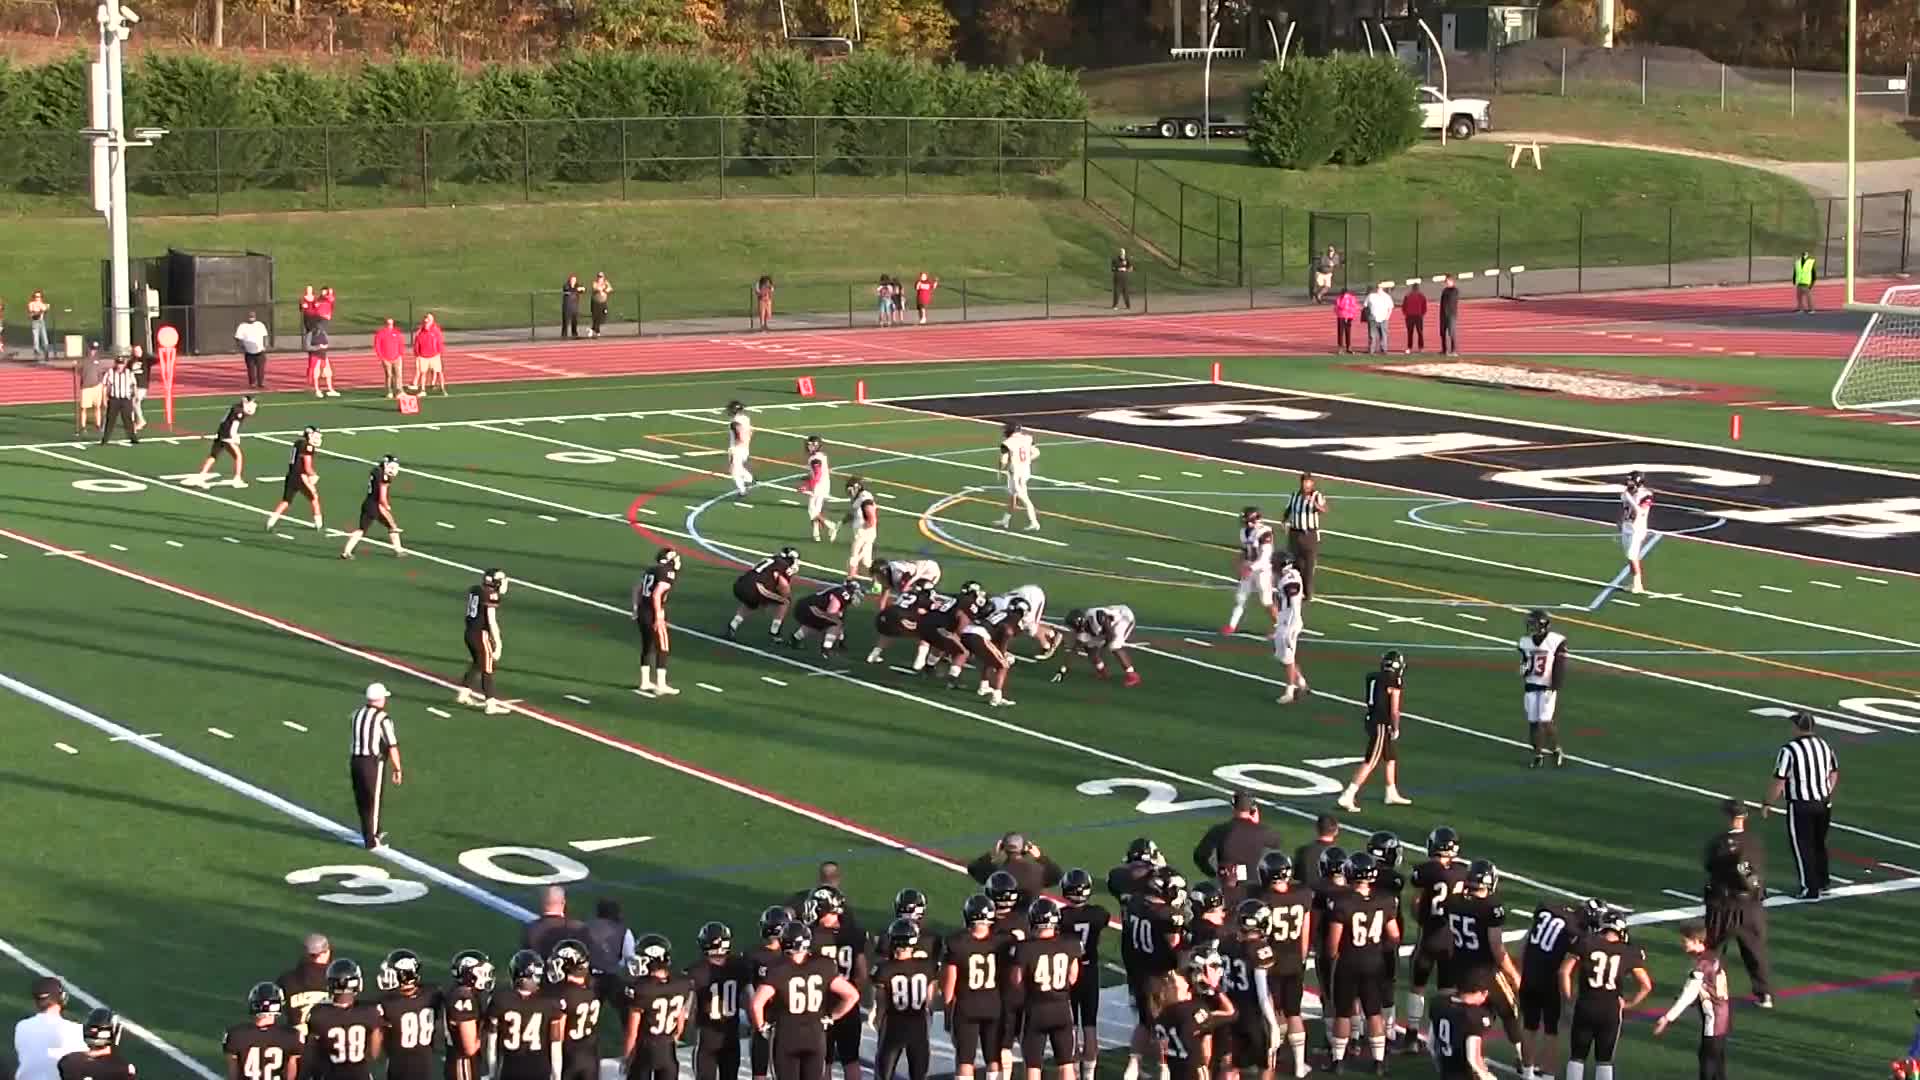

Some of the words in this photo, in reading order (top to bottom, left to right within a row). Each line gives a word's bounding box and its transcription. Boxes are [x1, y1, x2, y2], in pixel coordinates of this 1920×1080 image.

[1130, 914, 1154, 953] 70
[1273, 904, 1304, 941] 53
[1352, 910, 1384, 947] 64
[1449, 913, 1480, 951] 55
[1530, 911, 1566, 952] 30
[968, 953, 996, 990] 61
[1034, 952, 1070, 992] 48
[1588, 951, 1621, 990] 31
[709, 979, 738, 1020] 10
[788, 974, 823, 1015] 66
[891, 972, 928, 1011] 80
[327, 1025, 367, 1064] 38
[400, 1007, 435, 1049] 88
[503, 1010, 543, 1051] 34
[243, 1046, 284, 1080] 42
